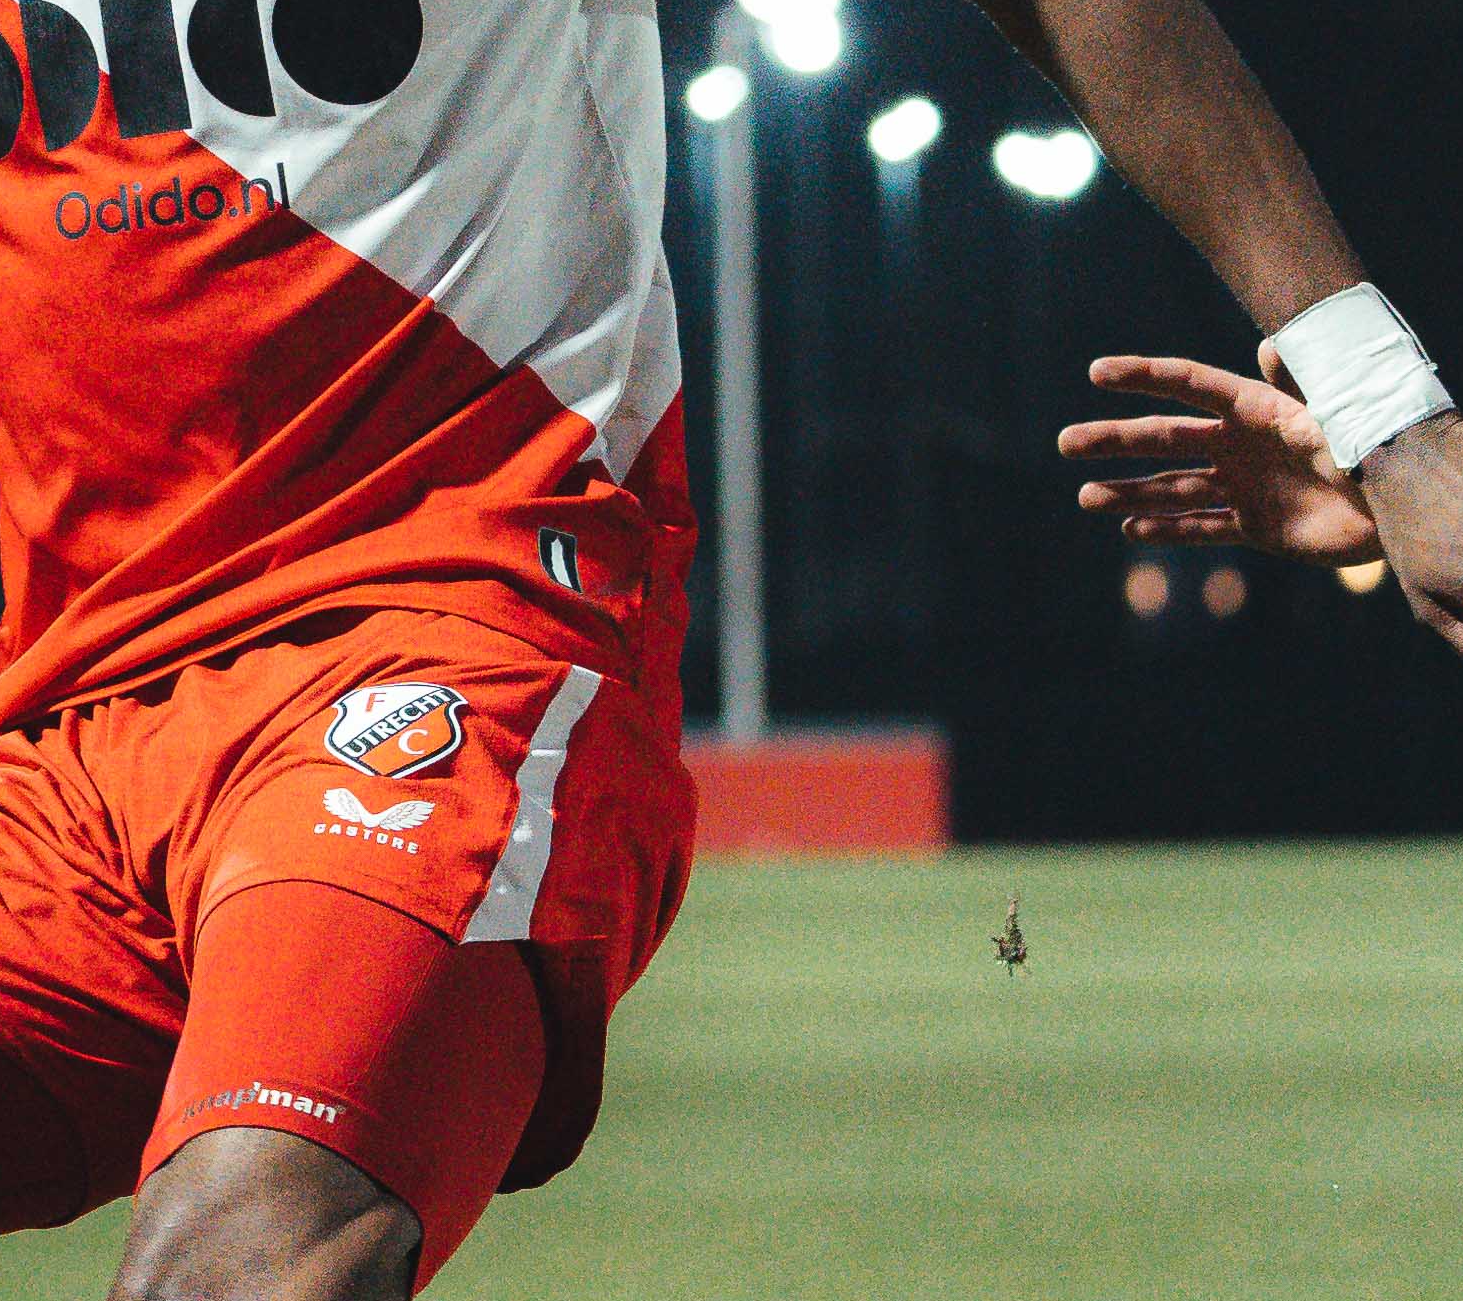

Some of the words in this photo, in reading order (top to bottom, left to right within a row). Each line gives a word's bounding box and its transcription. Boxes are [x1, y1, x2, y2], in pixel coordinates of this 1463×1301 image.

[55, 162, 291, 240] Odido.nl
[366, 692, 387, 712] F
[340, 690, 454, 758] UTRECHT
[398, 729, 430, 756] C
[314, 823, 420, 854] CASTORE
